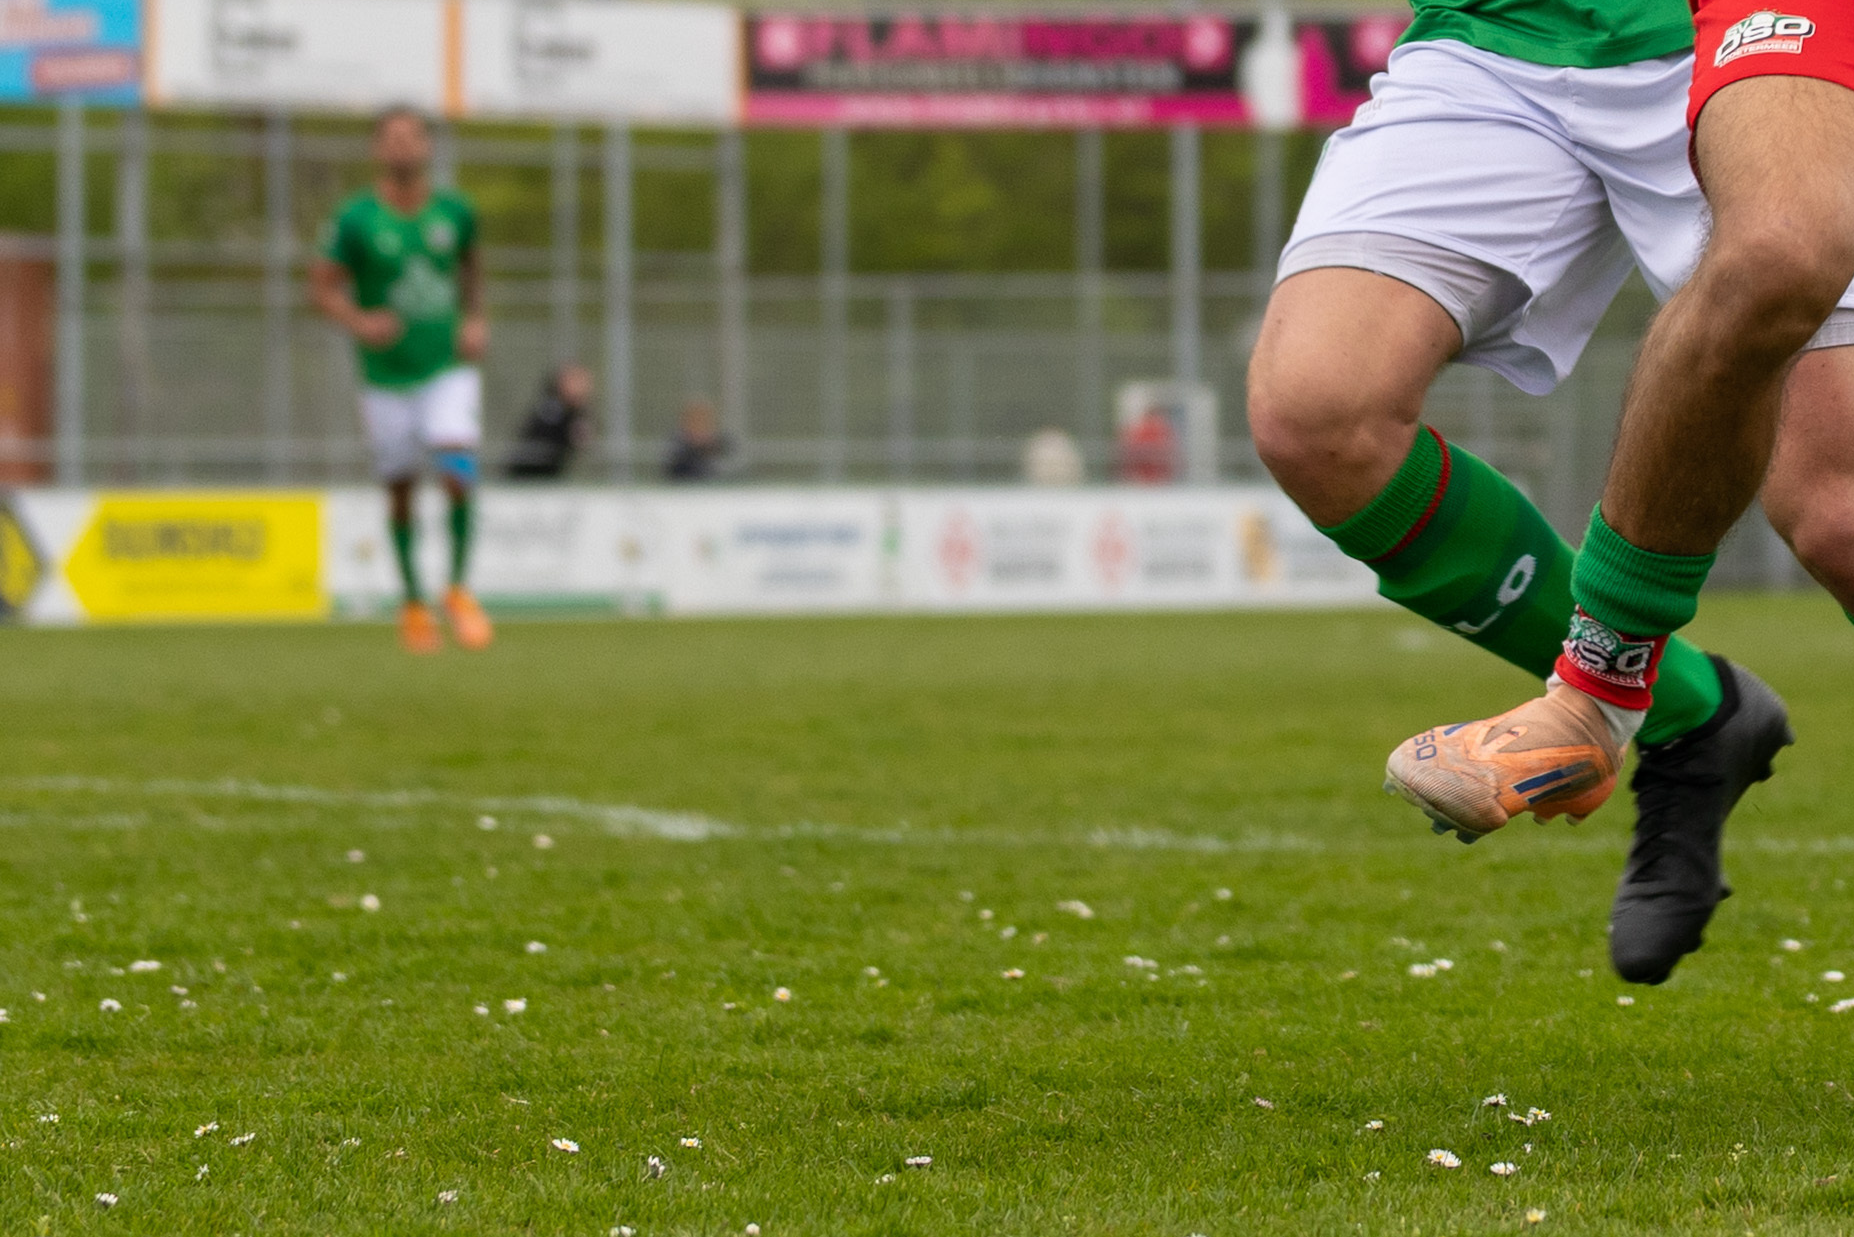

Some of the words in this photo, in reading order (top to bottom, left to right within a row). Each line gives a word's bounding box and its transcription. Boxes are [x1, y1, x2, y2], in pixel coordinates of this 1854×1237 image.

[1713, 18, 1812, 67] DSO
[1563, 637, 1651, 674] SO
[1413, 727, 1438, 761] 50
